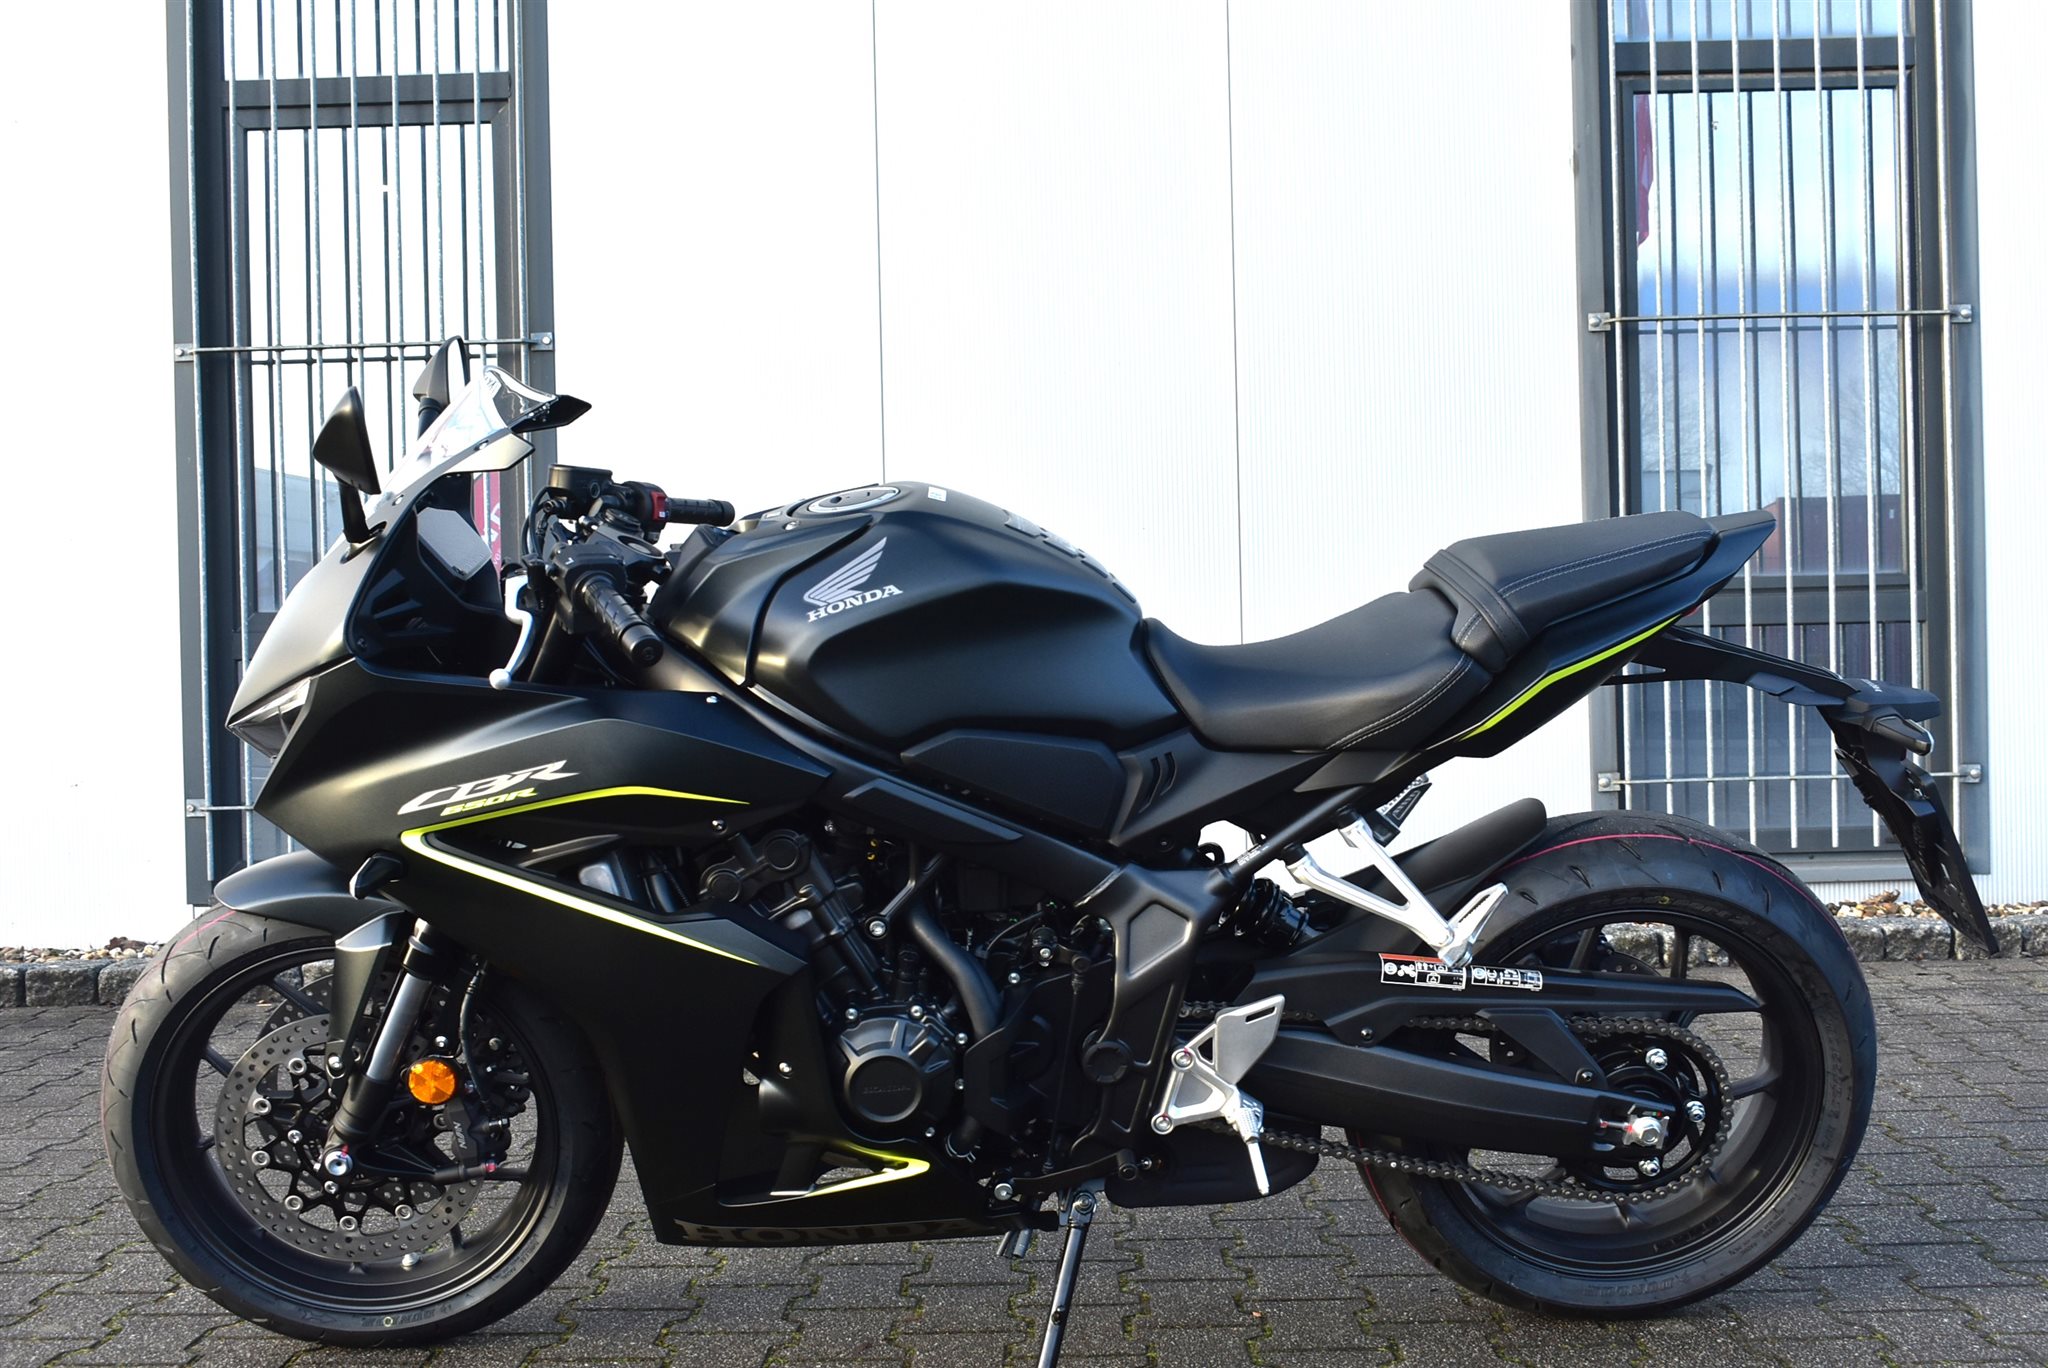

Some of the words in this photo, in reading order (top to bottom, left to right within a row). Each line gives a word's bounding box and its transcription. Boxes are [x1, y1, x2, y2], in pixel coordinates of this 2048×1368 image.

[806, 584, 903, 623] HONDA
[397, 759, 581, 815] CBR
[440, 787, 539, 817] 650R
[673, 1217, 996, 1244] HONDA
